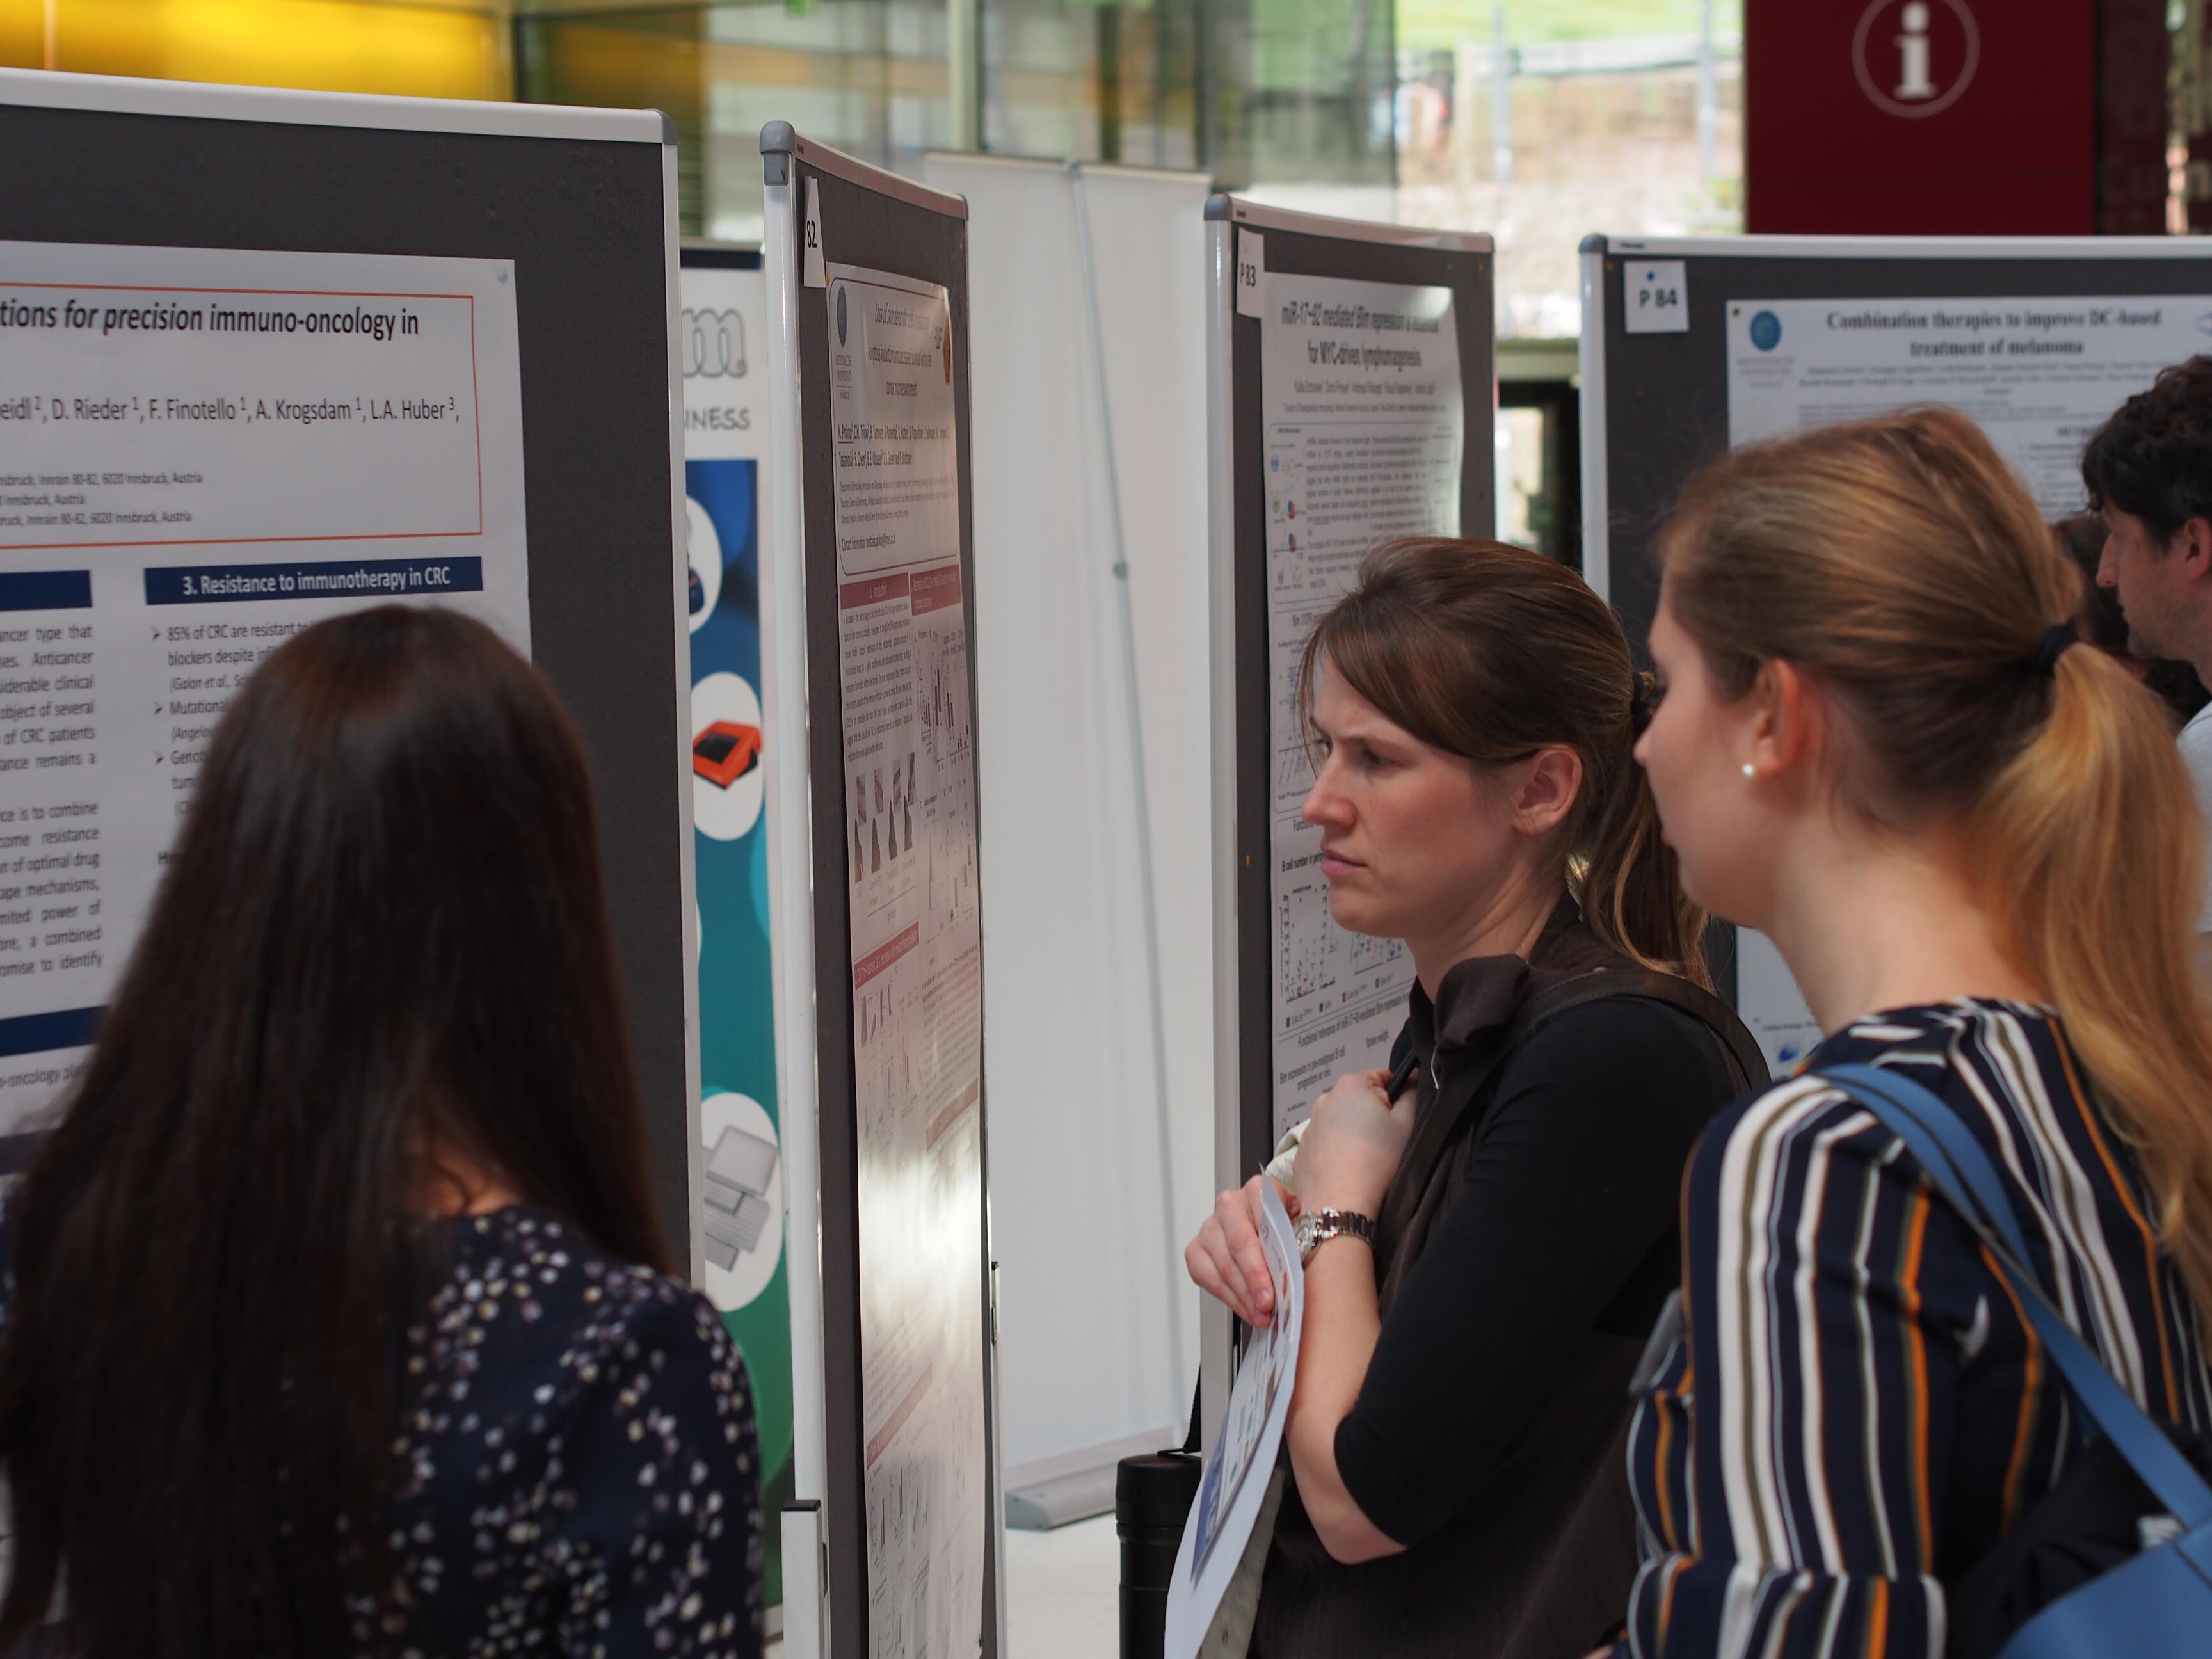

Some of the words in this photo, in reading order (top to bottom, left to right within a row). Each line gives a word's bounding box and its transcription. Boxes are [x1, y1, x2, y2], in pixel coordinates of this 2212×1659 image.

[807, 221, 817, 248] 82
[1246, 264, 1256, 287] 83
[1639, 289, 1651, 308] P
[1655, 288, 1678, 307] 84
[64, 299, 99, 329] for
[103, 302, 203, 336] precision
[209, 303, 396, 341] immuno-oncology
[400, 307, 419, 335] in
[1827, 310, 1928, 329] Combination
[2023, 310, 2084, 333] improve
[1909, 340, 1985, 357] treatment
[2007, 338, 2085, 355] melanoma
[73, 397, 127, 421] Rieder
[166, 397, 236, 421] Finotello
[256, 399, 271, 421] A.
[275, 398, 351, 425] Krogsdam
[371, 399, 397, 421] L.A.
[400, 397, 446, 421] Huber
[182, 575, 198, 595] 3.
[200, 574, 276, 595] Resistance
[278, 573, 294, 591] to
[296, 571, 405, 591] immunotherapy
[408, 566, 422, 586] in
[424, 566, 451, 586] CRC
[68, 623, 93, 639] that
[207, 624, 228, 639] CRC
[230, 626, 248, 639] are
[250, 622, 294, 637] resistant
[33, 652, 94, 666] Anticancer
[168, 650, 212, 666] blockers
[214, 648, 254, 666] despite
[55, 673, 94, 691] clinical
[54, 699, 95, 716] several
[20, 728, 45, 744] CRC
[49, 726, 95, 745] patients
[36, 751, 82, 769] remains
[48, 800, 98, 819] combine
[42, 828, 99, 845] resistance
[27, 853, 70, 874] optimal
[72, 850, 100, 869] drug
[26, 877, 100, 897] mechanisms,
[41, 906, 79, 924] power
[44, 926, 102, 946] combined
[59, 949, 102, 970] identify
